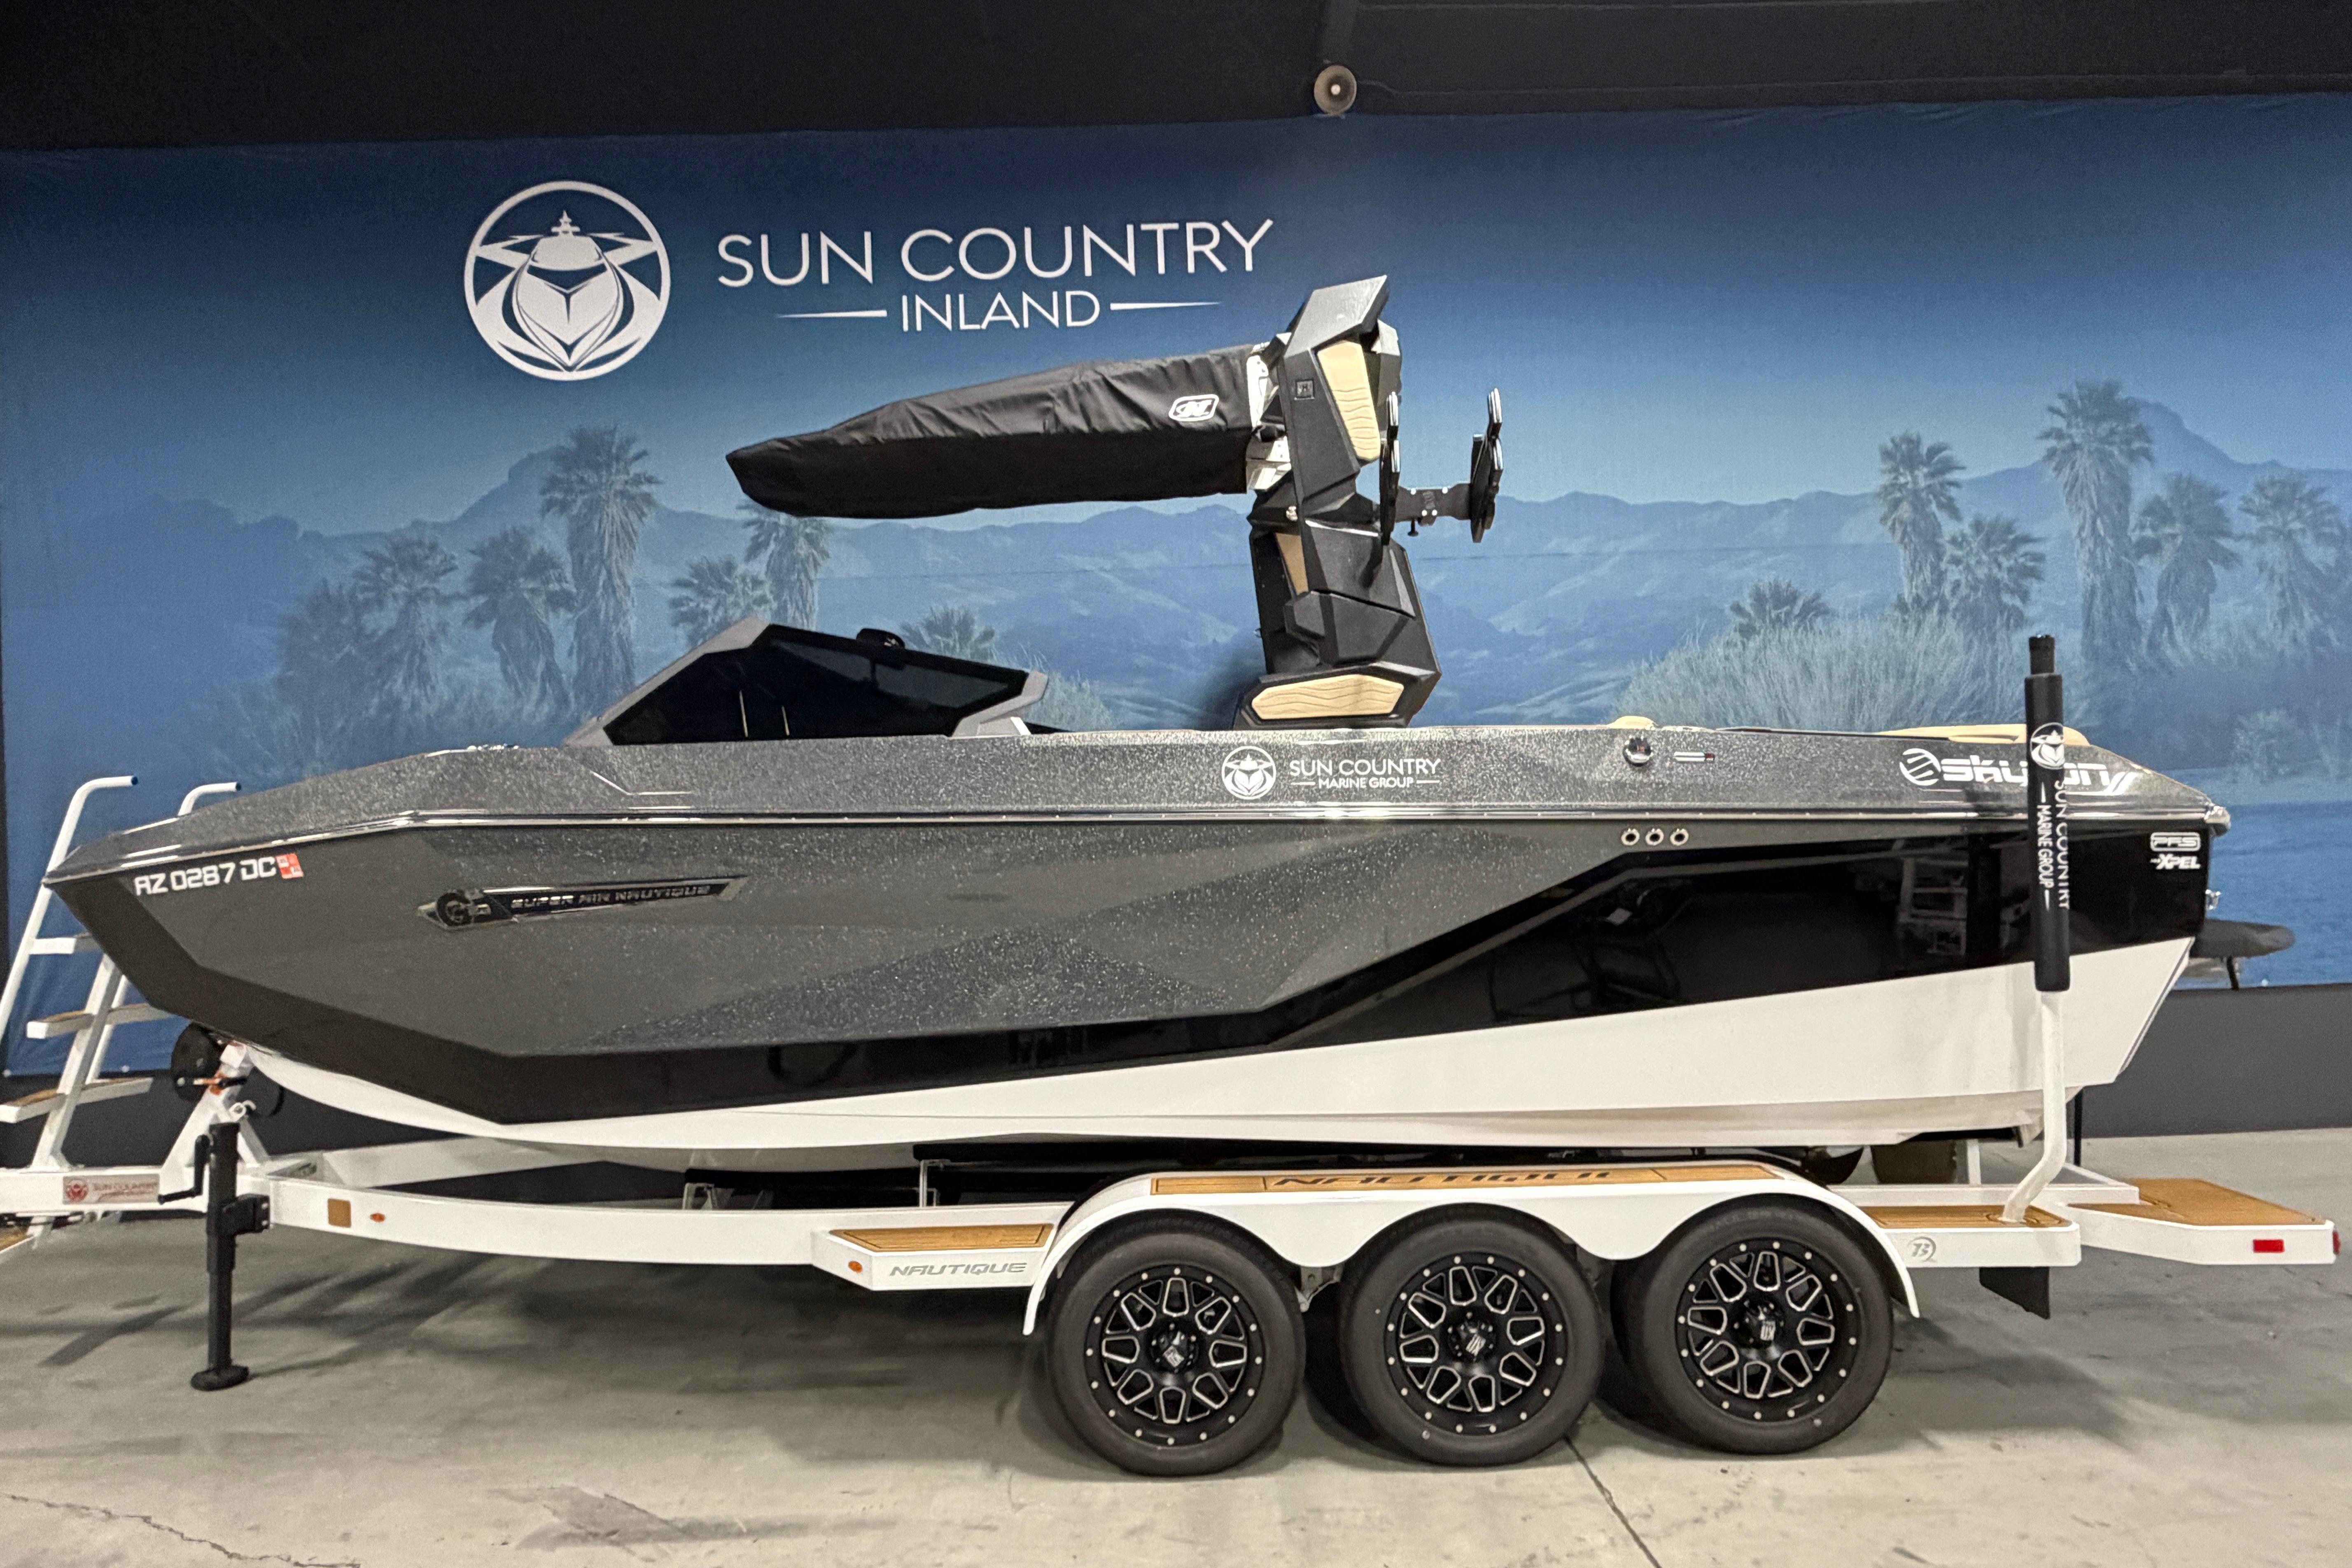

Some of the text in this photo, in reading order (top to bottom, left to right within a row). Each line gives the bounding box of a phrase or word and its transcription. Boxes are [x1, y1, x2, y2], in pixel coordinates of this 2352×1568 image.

[718, 219, 1274, 287] SUN COUNTRY
[902, 290, 1101, 332] INLAND
[1289, 758, 1441, 776] SUN COUNTRY
[1941, 755, 2110, 787] skyon
[1318, 776, 1414, 789] MARINE GROUP
[2037, 805, 2055, 888] MARINE GROUP
[2155, 853, 2201, 870] XPEL
[134, 873, 169, 896] AZ
[170, 862, 236, 891] 0287
[240, 856, 277, 880] DC
[511, 895, 574, 908] SUPER
[889, 1262, 1027, 1276] NAUTIQUE
